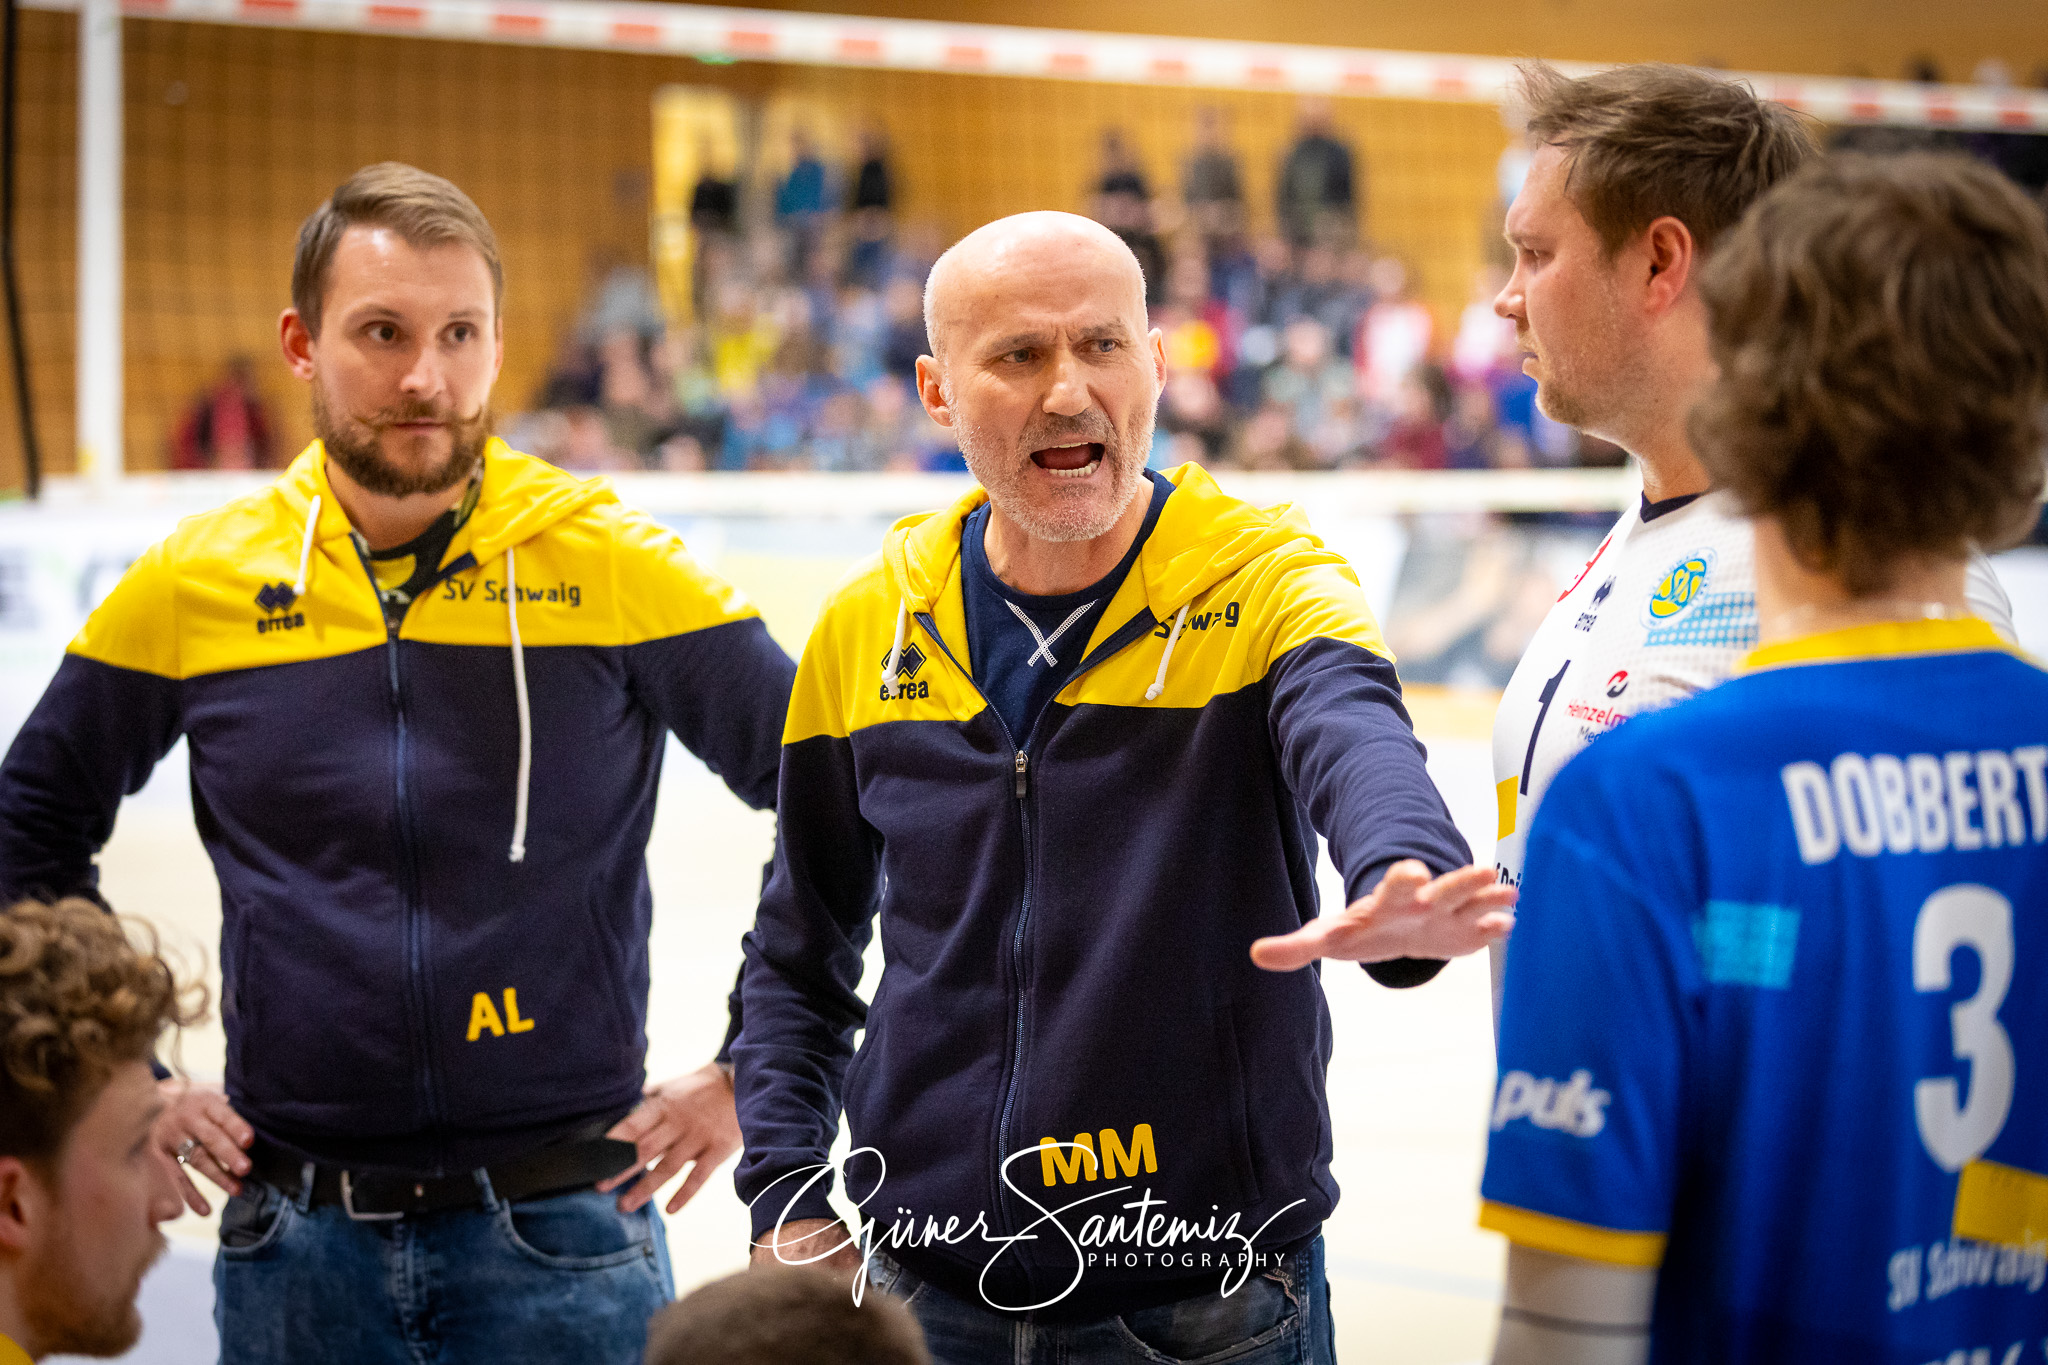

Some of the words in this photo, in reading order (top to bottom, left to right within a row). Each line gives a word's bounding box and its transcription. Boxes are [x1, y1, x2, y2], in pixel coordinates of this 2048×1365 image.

[443, 577, 475, 600] SV
[879, 680, 929, 701] erea
[1781, 745, 2048, 866] DOBBERT
[465, 987, 535, 1042] AL
[1912, 883, 2016, 1173] 3
[1491, 1069, 1612, 1138] puls
[1039, 1123, 1158, 1187] MM
